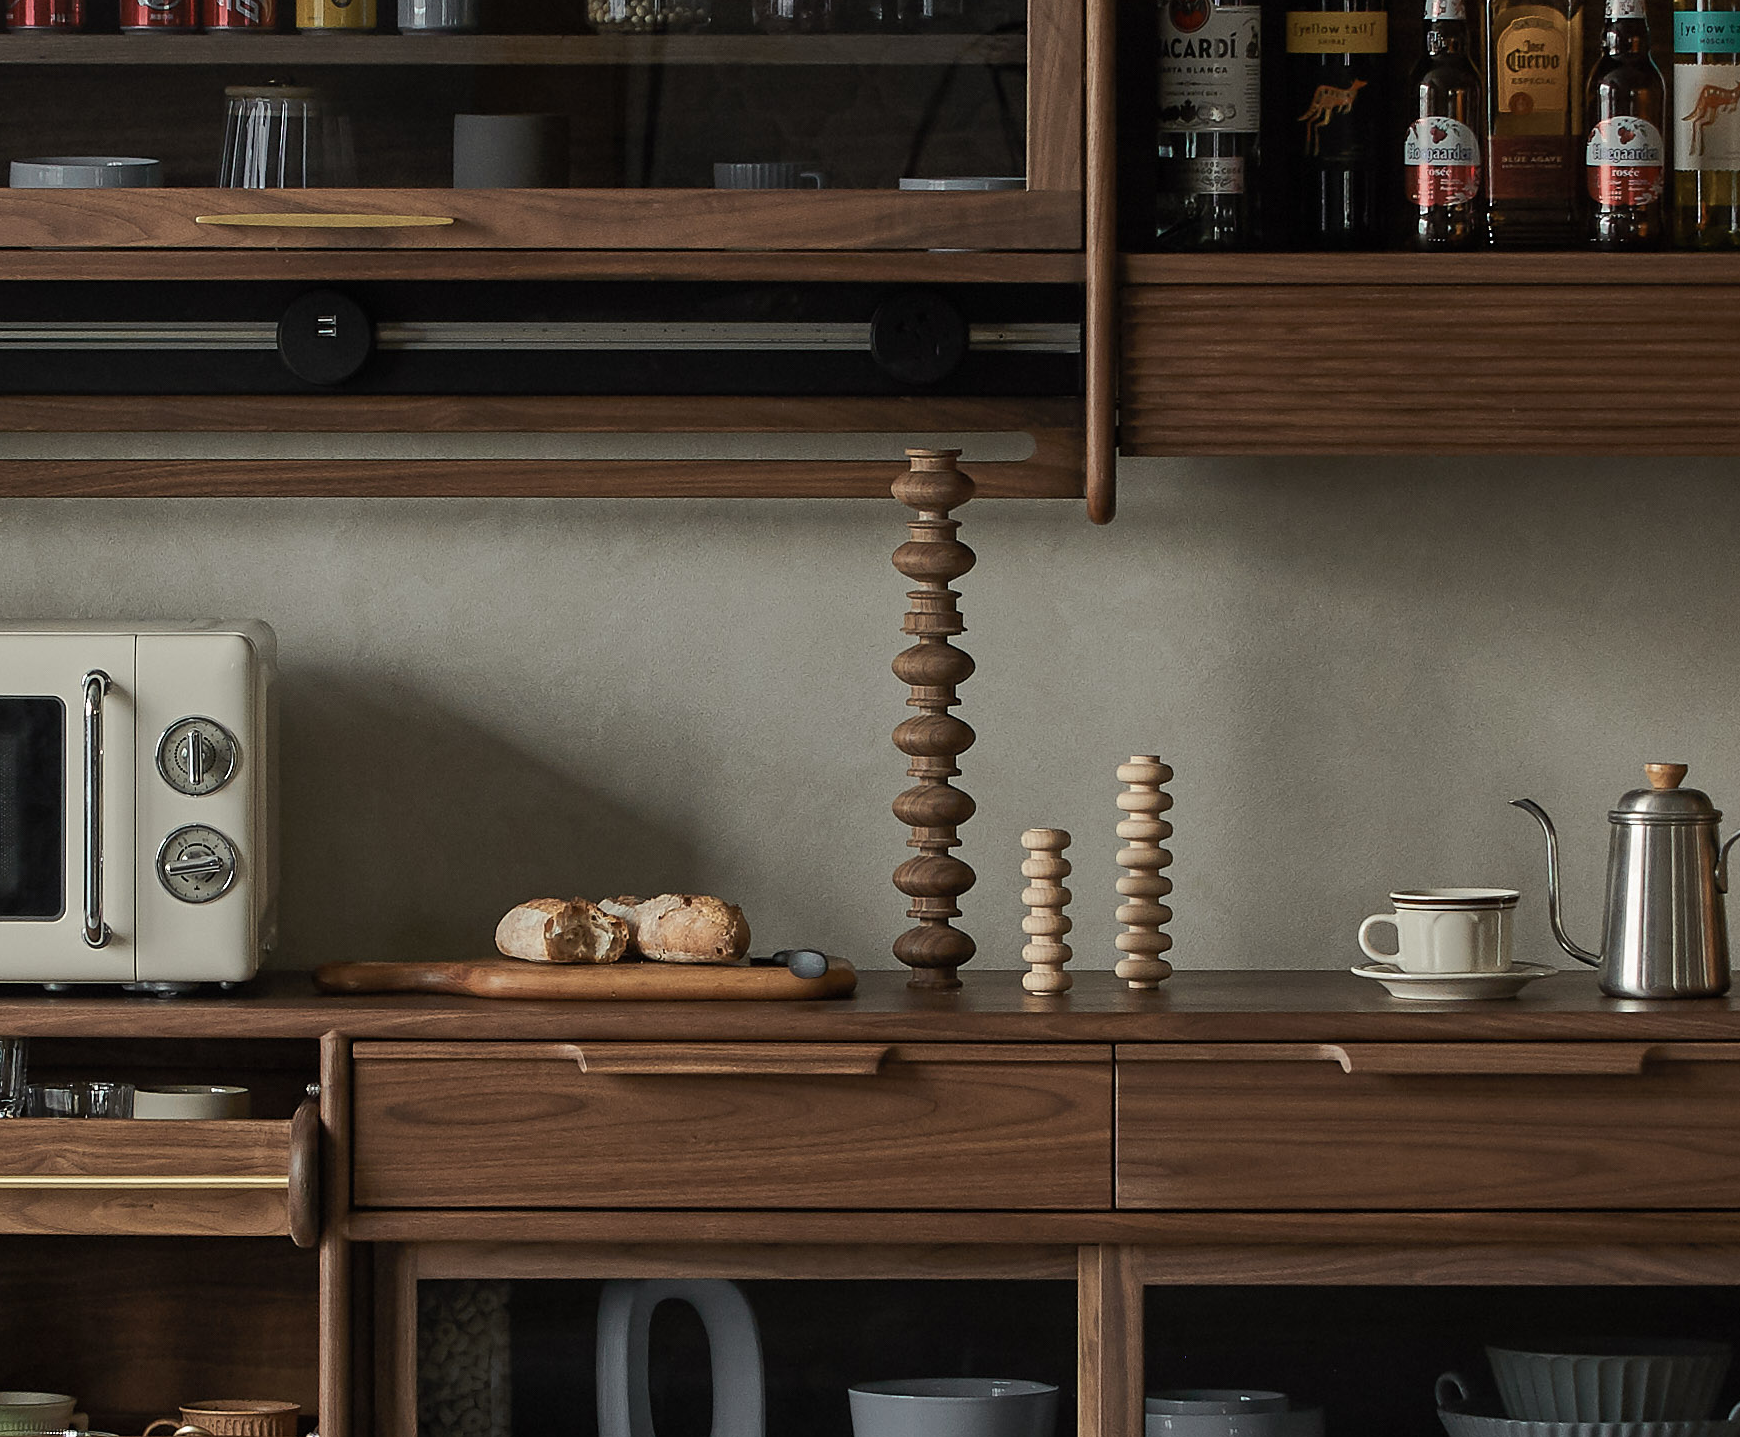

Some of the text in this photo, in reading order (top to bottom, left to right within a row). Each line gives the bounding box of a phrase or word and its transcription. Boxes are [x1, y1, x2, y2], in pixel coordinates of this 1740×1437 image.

[1160, 32, 1238, 59] ACARDÍ
[1186, 66, 1228, 74] BLANCA
[1506, 48, 1560, 73] Cuervo
[1408, 142, 1472, 164] Hogaarden
